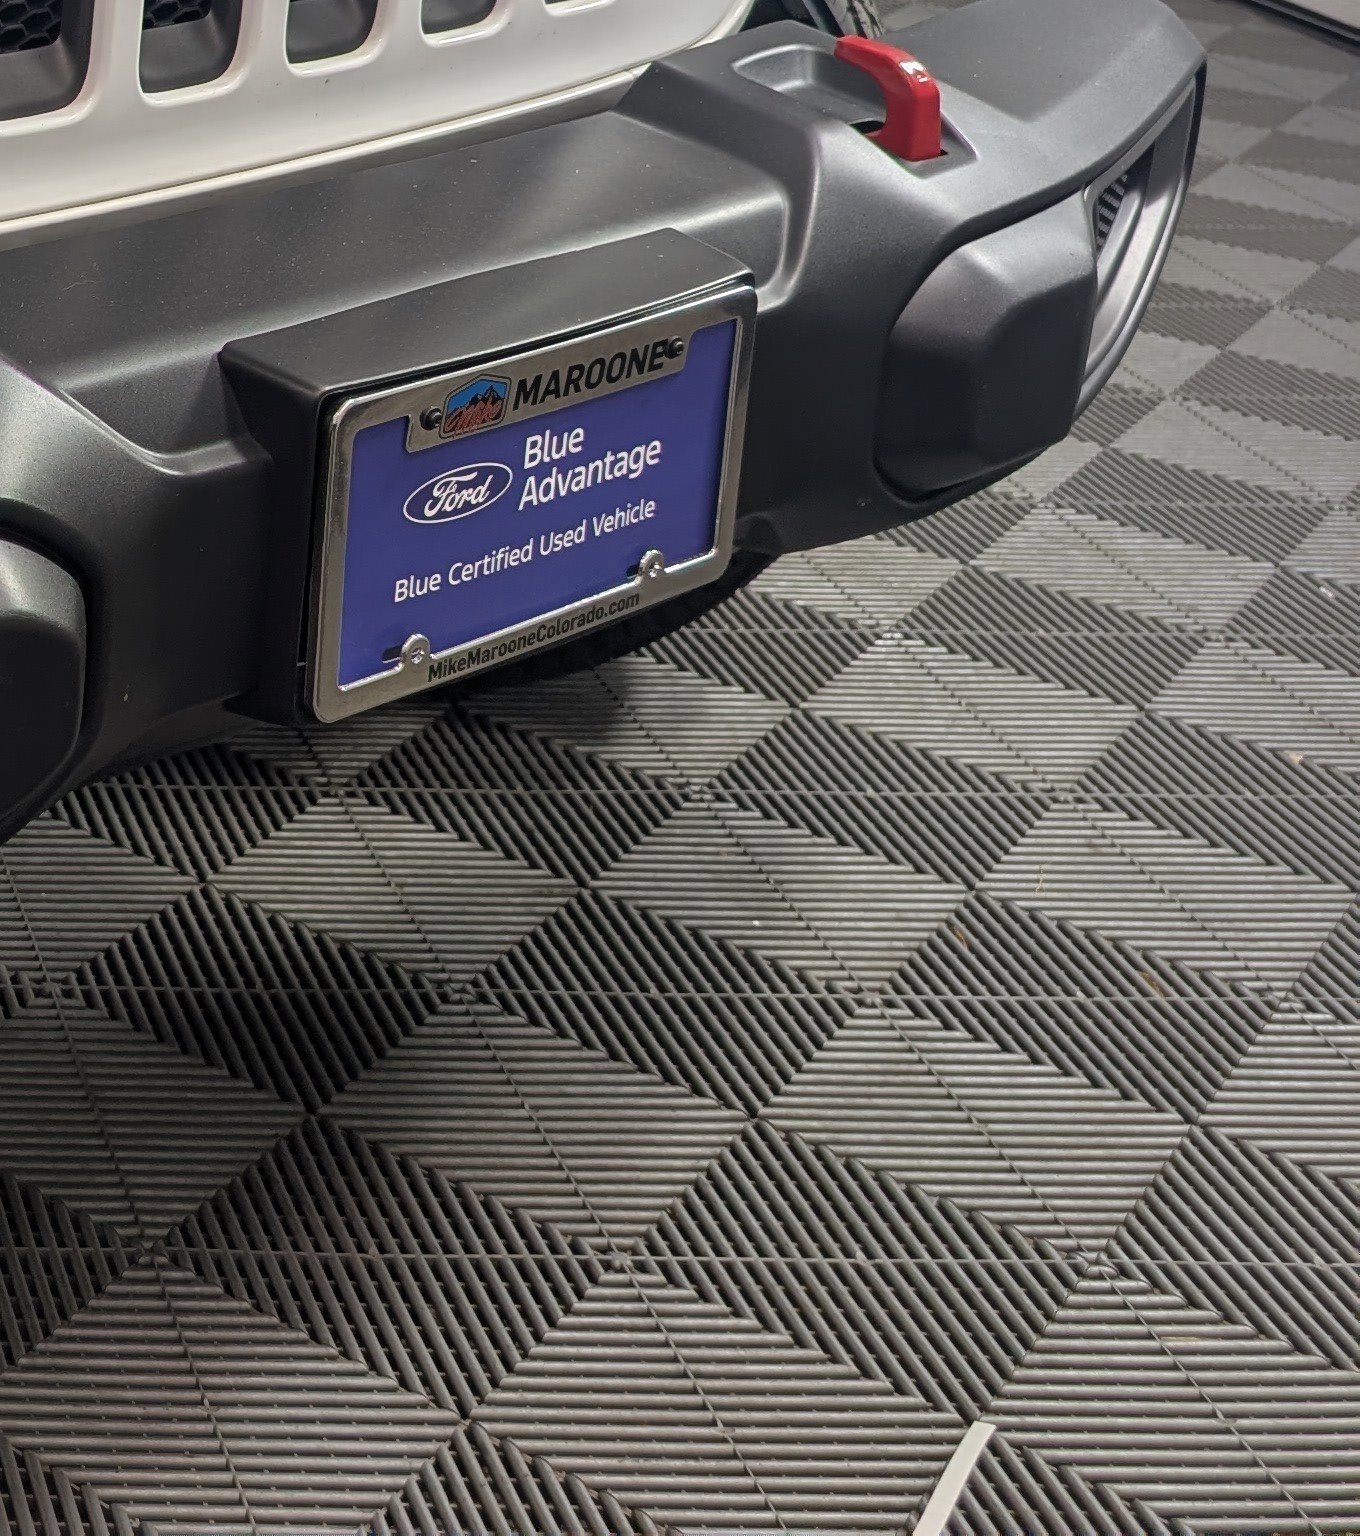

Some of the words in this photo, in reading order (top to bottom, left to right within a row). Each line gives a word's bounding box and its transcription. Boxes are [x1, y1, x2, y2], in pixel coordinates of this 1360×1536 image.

[512, 340, 668, 412] MAROONE
[518, 439, 662, 511] Advantage
[523, 427, 585, 470] Blue
[423, 472, 495, 519] Ford
[394, 573, 441, 603] Blue
[448, 543, 533, 585] Certified
[539, 519, 587, 556] Used
[593, 498, 656, 538] Vehicle
[427, 591, 640, 682] MikeMarooneColorado.com
